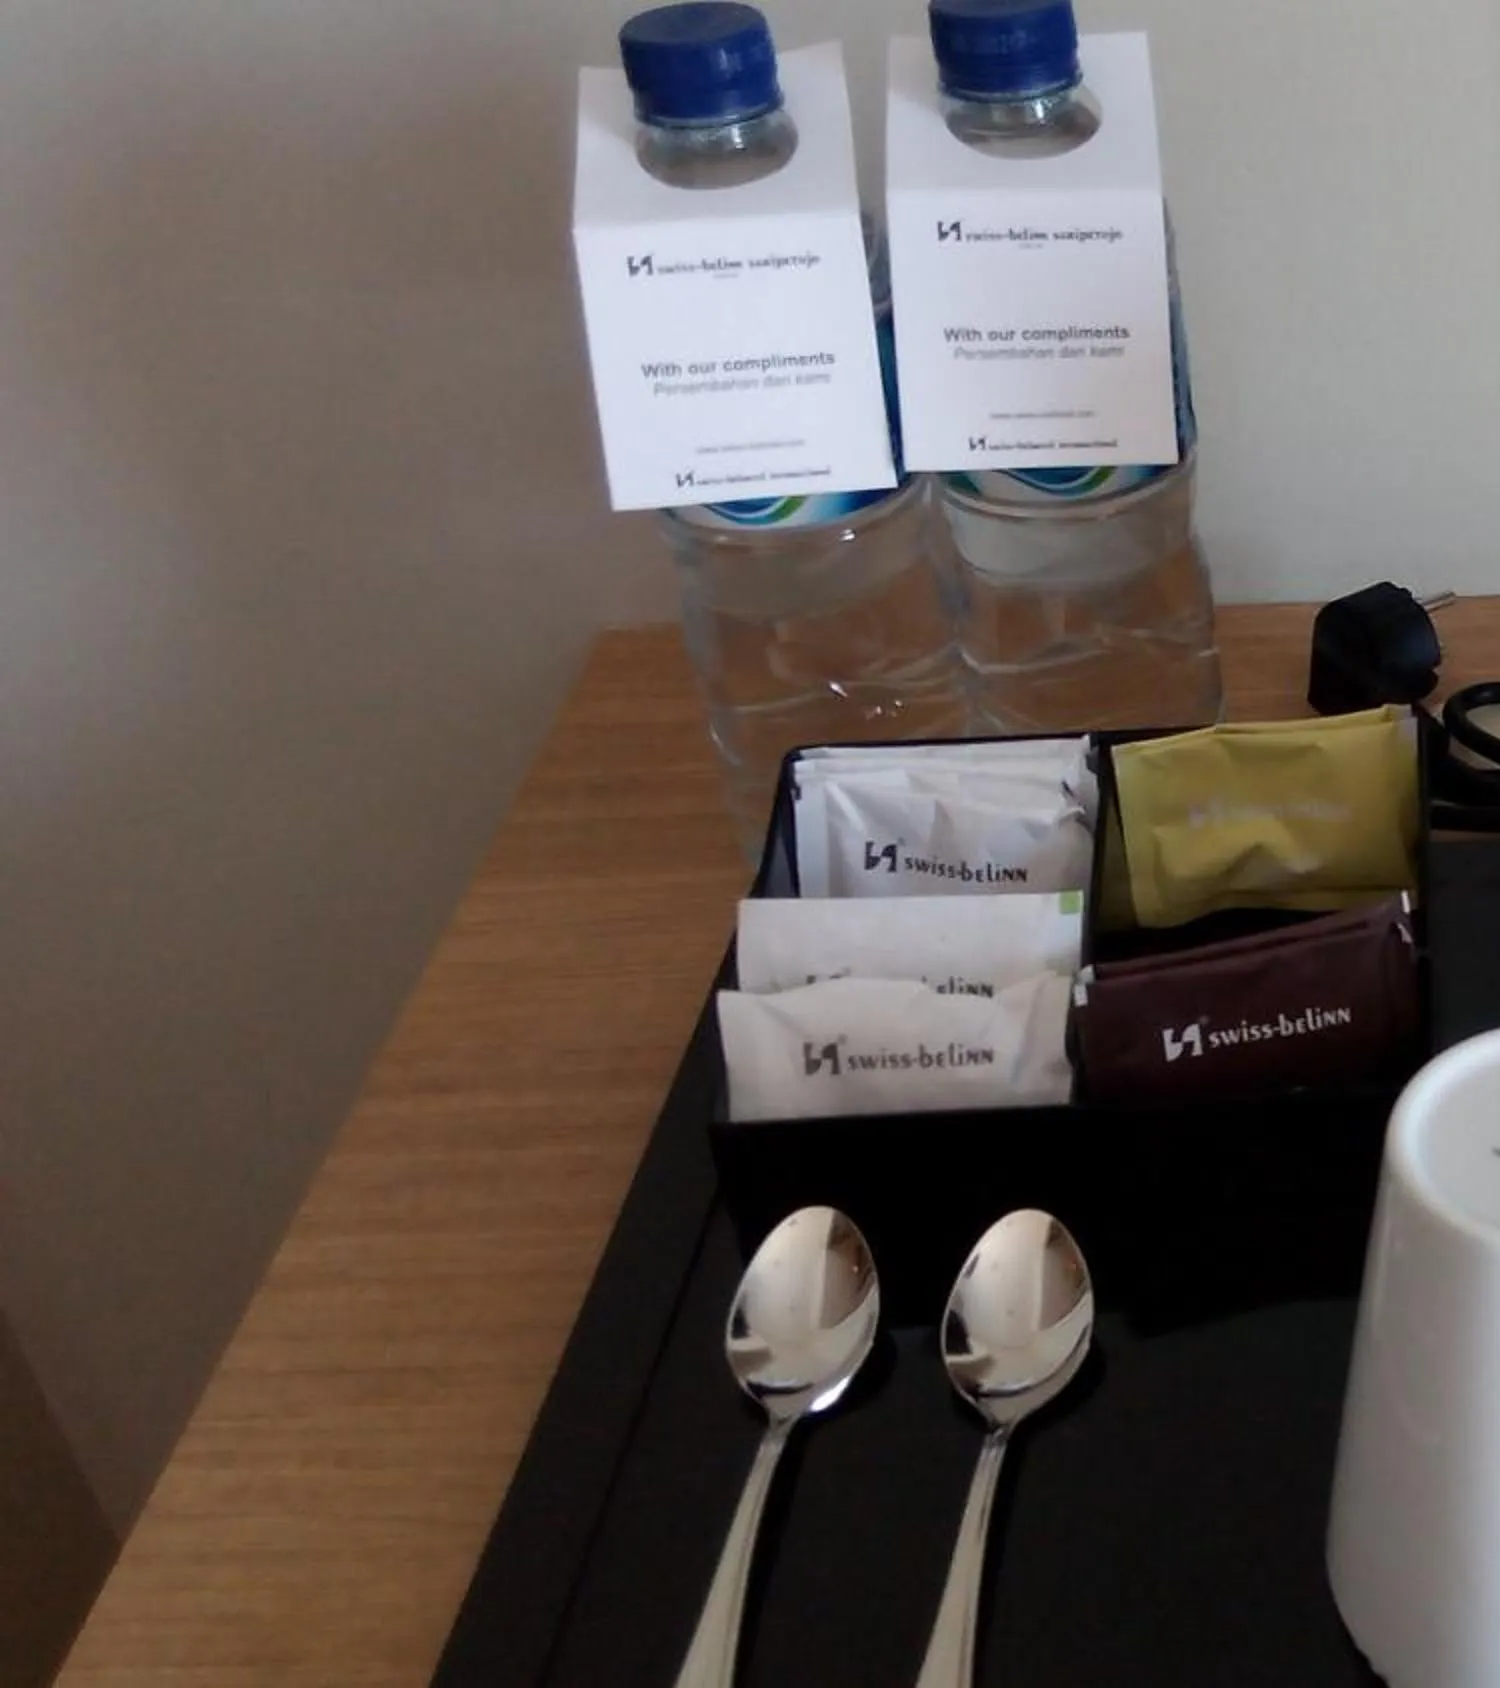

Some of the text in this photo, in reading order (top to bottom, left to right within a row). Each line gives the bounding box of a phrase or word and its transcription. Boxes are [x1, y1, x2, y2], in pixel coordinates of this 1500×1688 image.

[944, 326, 1130, 343] With our compliments
[641, 352, 836, 378] With our compliments
